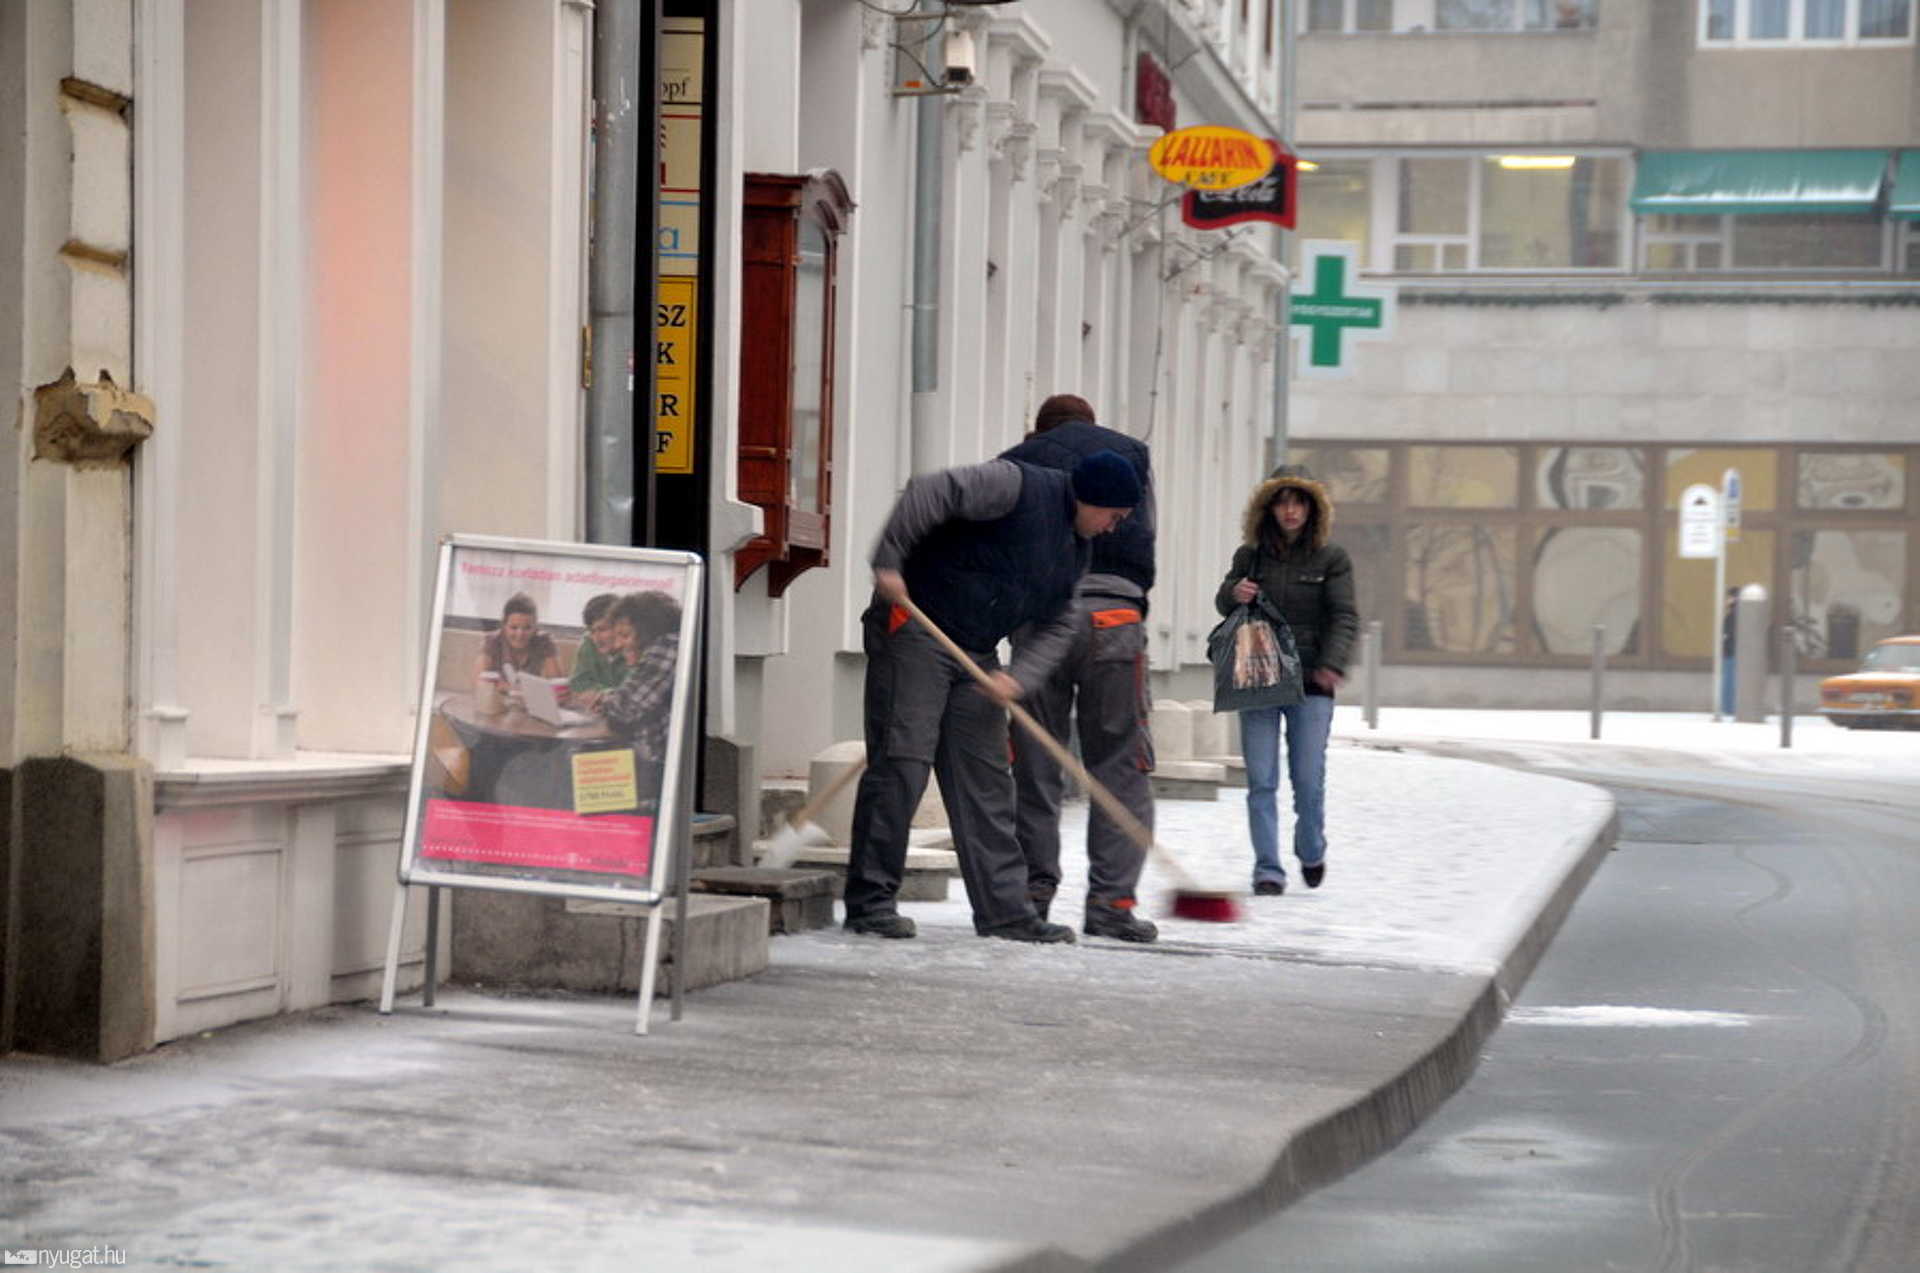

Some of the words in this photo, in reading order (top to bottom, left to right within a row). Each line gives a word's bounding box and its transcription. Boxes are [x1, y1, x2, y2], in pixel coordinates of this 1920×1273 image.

[656, 342, 676, 365] K
[659, 394, 680, 417] R
[656, 432, 673, 453] F
